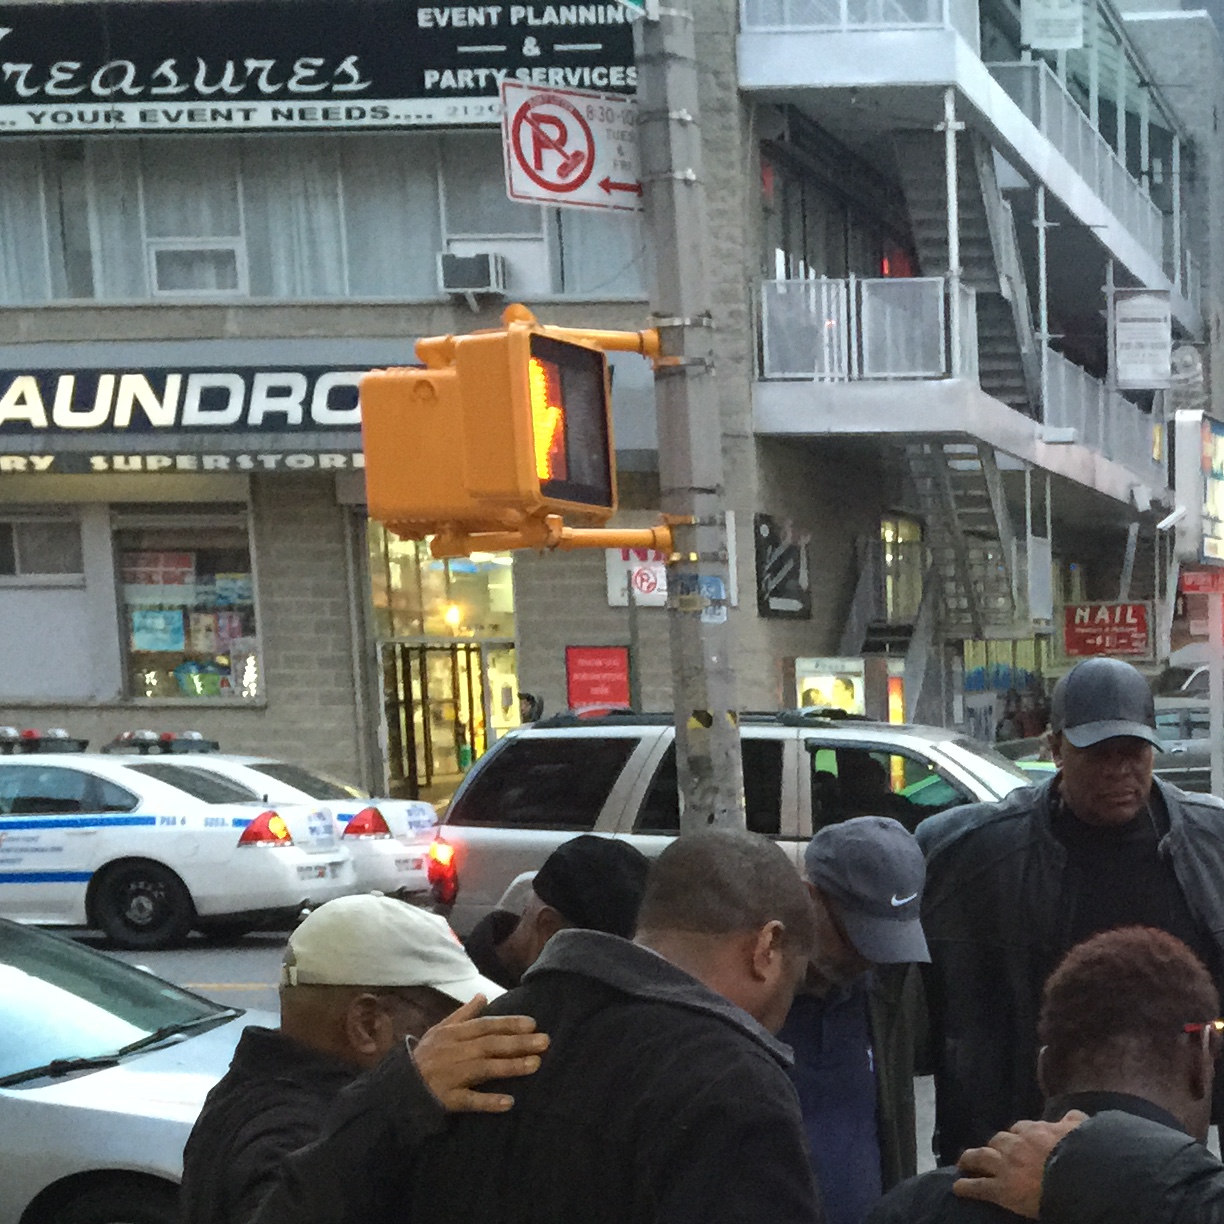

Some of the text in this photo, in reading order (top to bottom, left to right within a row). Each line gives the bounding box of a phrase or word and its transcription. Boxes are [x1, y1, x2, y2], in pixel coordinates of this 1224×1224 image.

[417, 6, 503, 28] EVENT
[522, 36, 541, 57] &
[424, 65, 637, 89] PARTY SERVICES
[27, 109, 126, 125] YOUR
[139, 107, 257, 123] EVENT
[0, 371, 362, 428] AUNDRO
